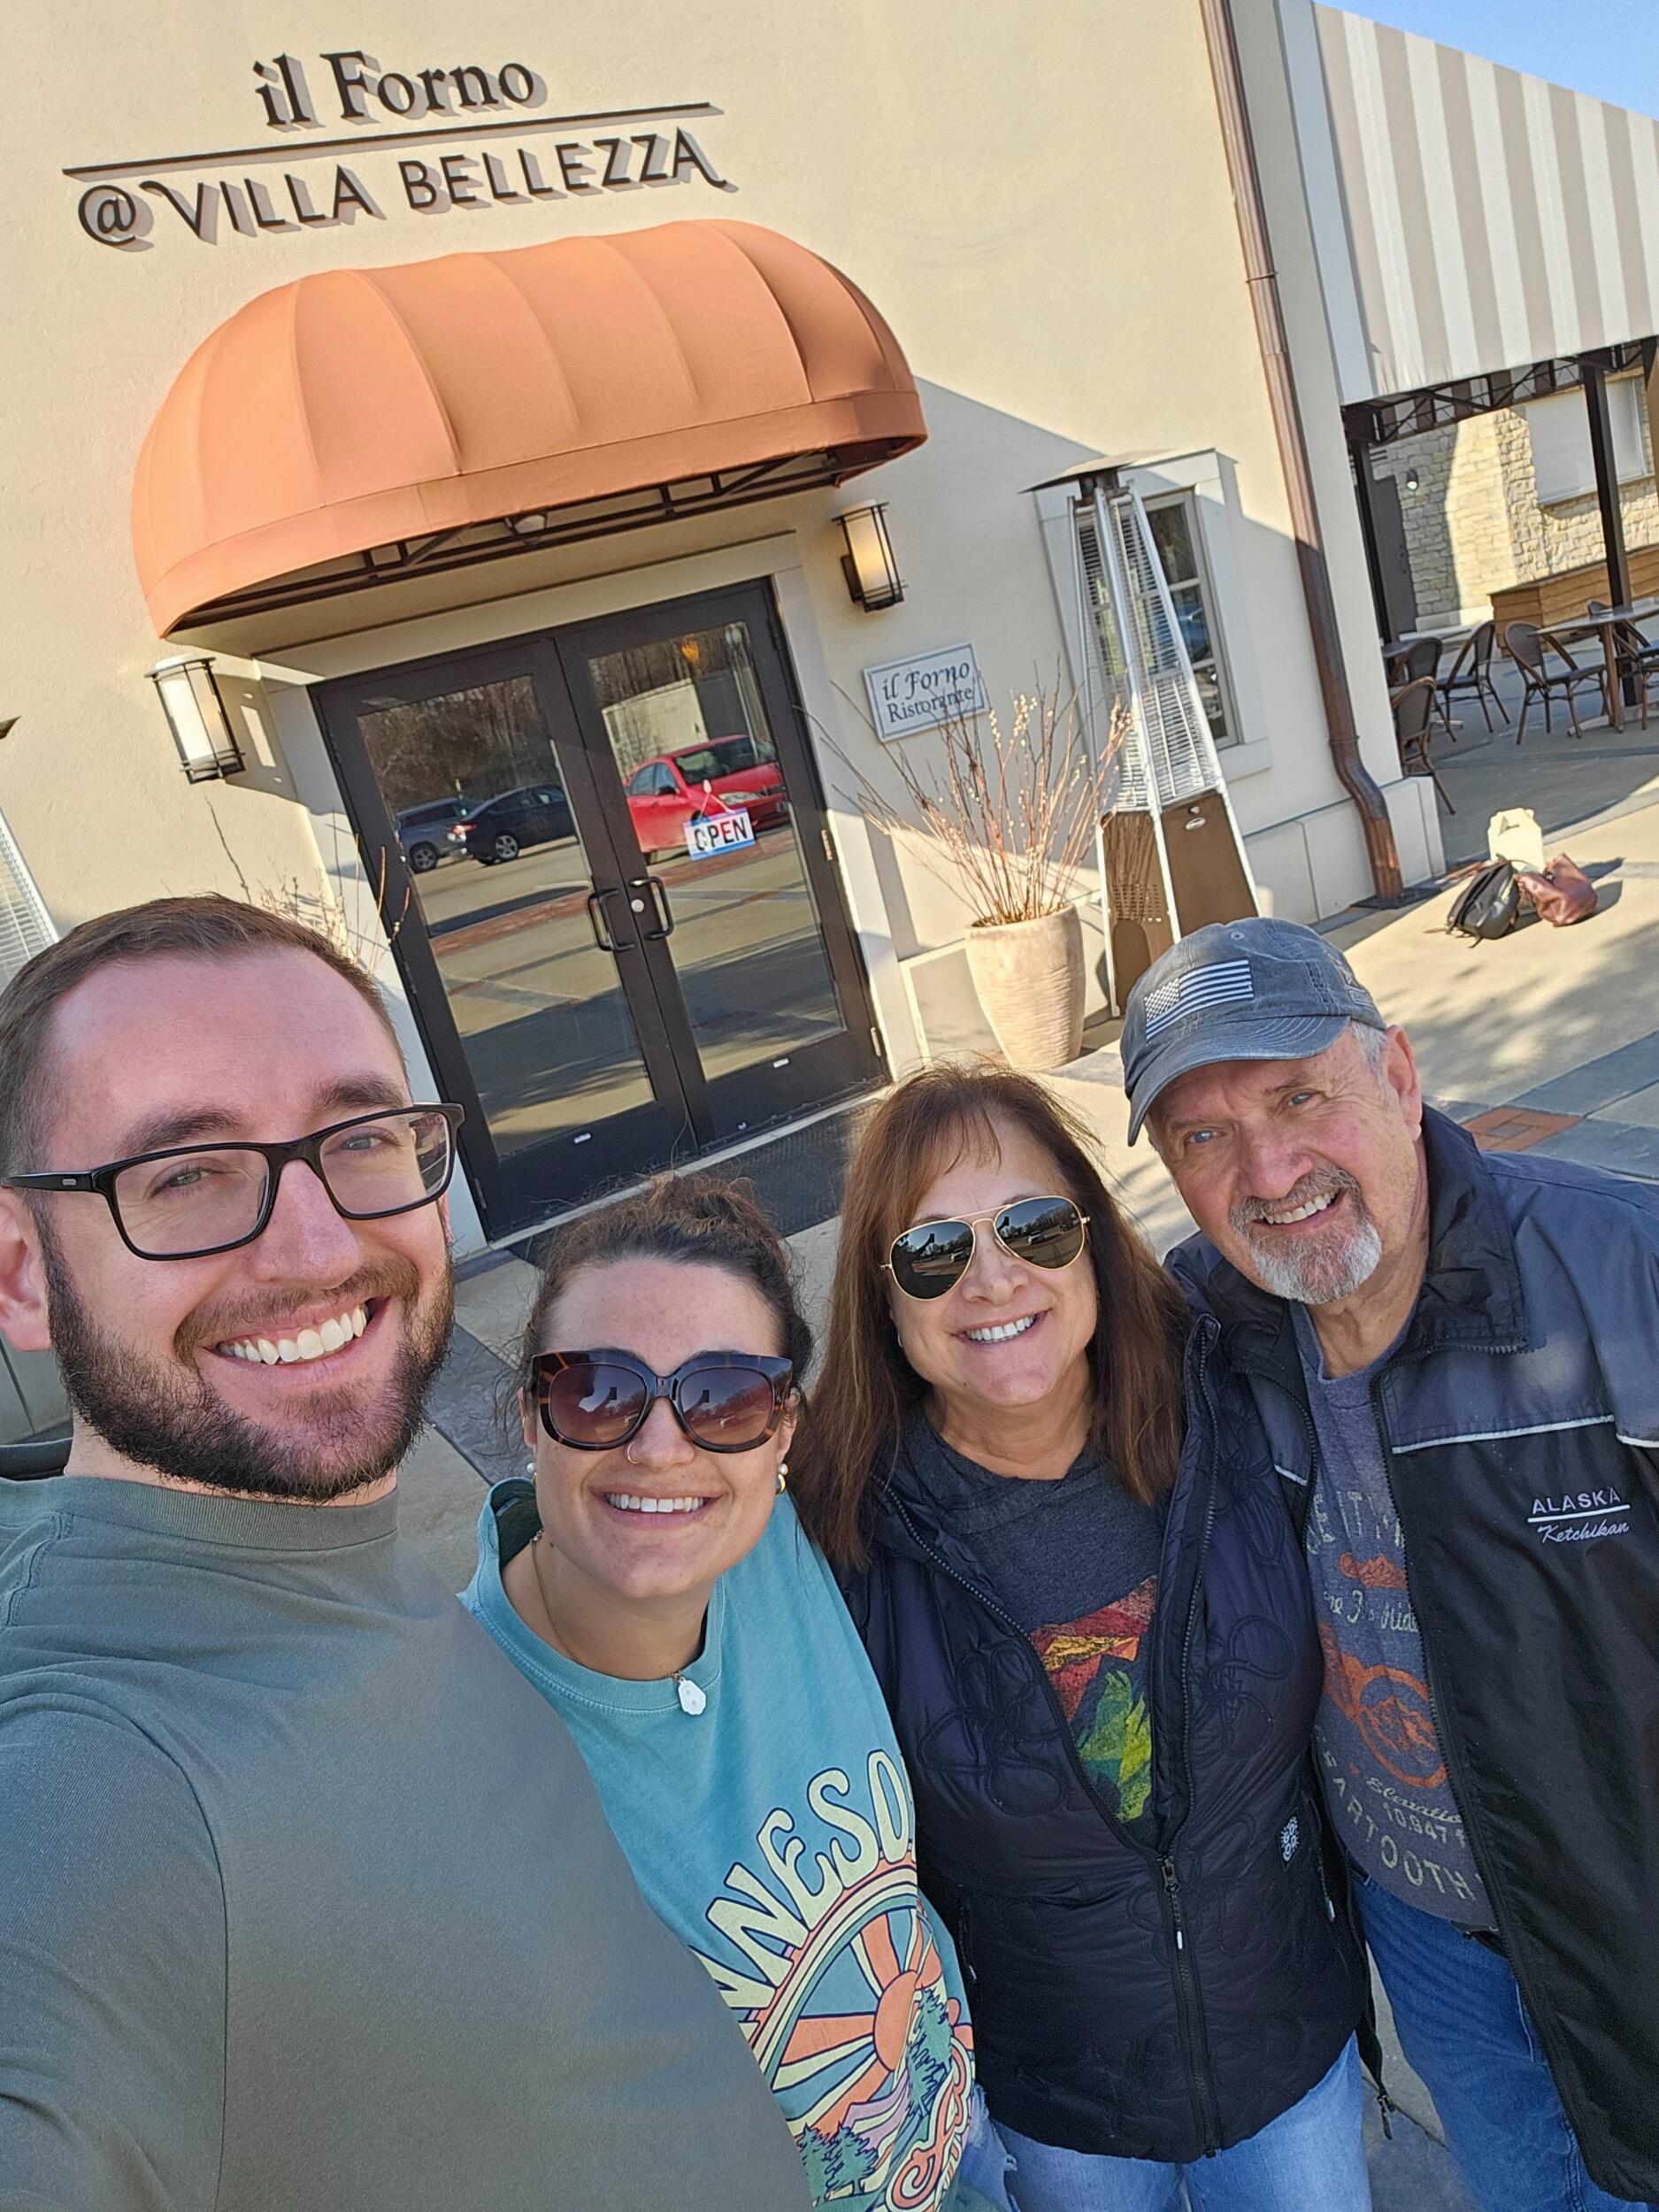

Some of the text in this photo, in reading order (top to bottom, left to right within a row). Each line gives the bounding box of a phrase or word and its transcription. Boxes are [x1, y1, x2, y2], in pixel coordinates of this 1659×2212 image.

[253, 50, 534, 127] il Forno
[141, 164, 375, 239] VILLA
[399, 127, 727, 211] BELLEZZA
[882, 662, 971, 701] il Forno
[887, 687, 973, 723] Ristorante
[694, 816, 749, 851] OPEN
[1532, 1486, 1621, 1515] ALASKA
[1537, 1518, 1630, 1543] Ketchikan
[1365, 1776, 1463, 1824] Elevatio
[687, 1748, 917, 2042] NNESO
